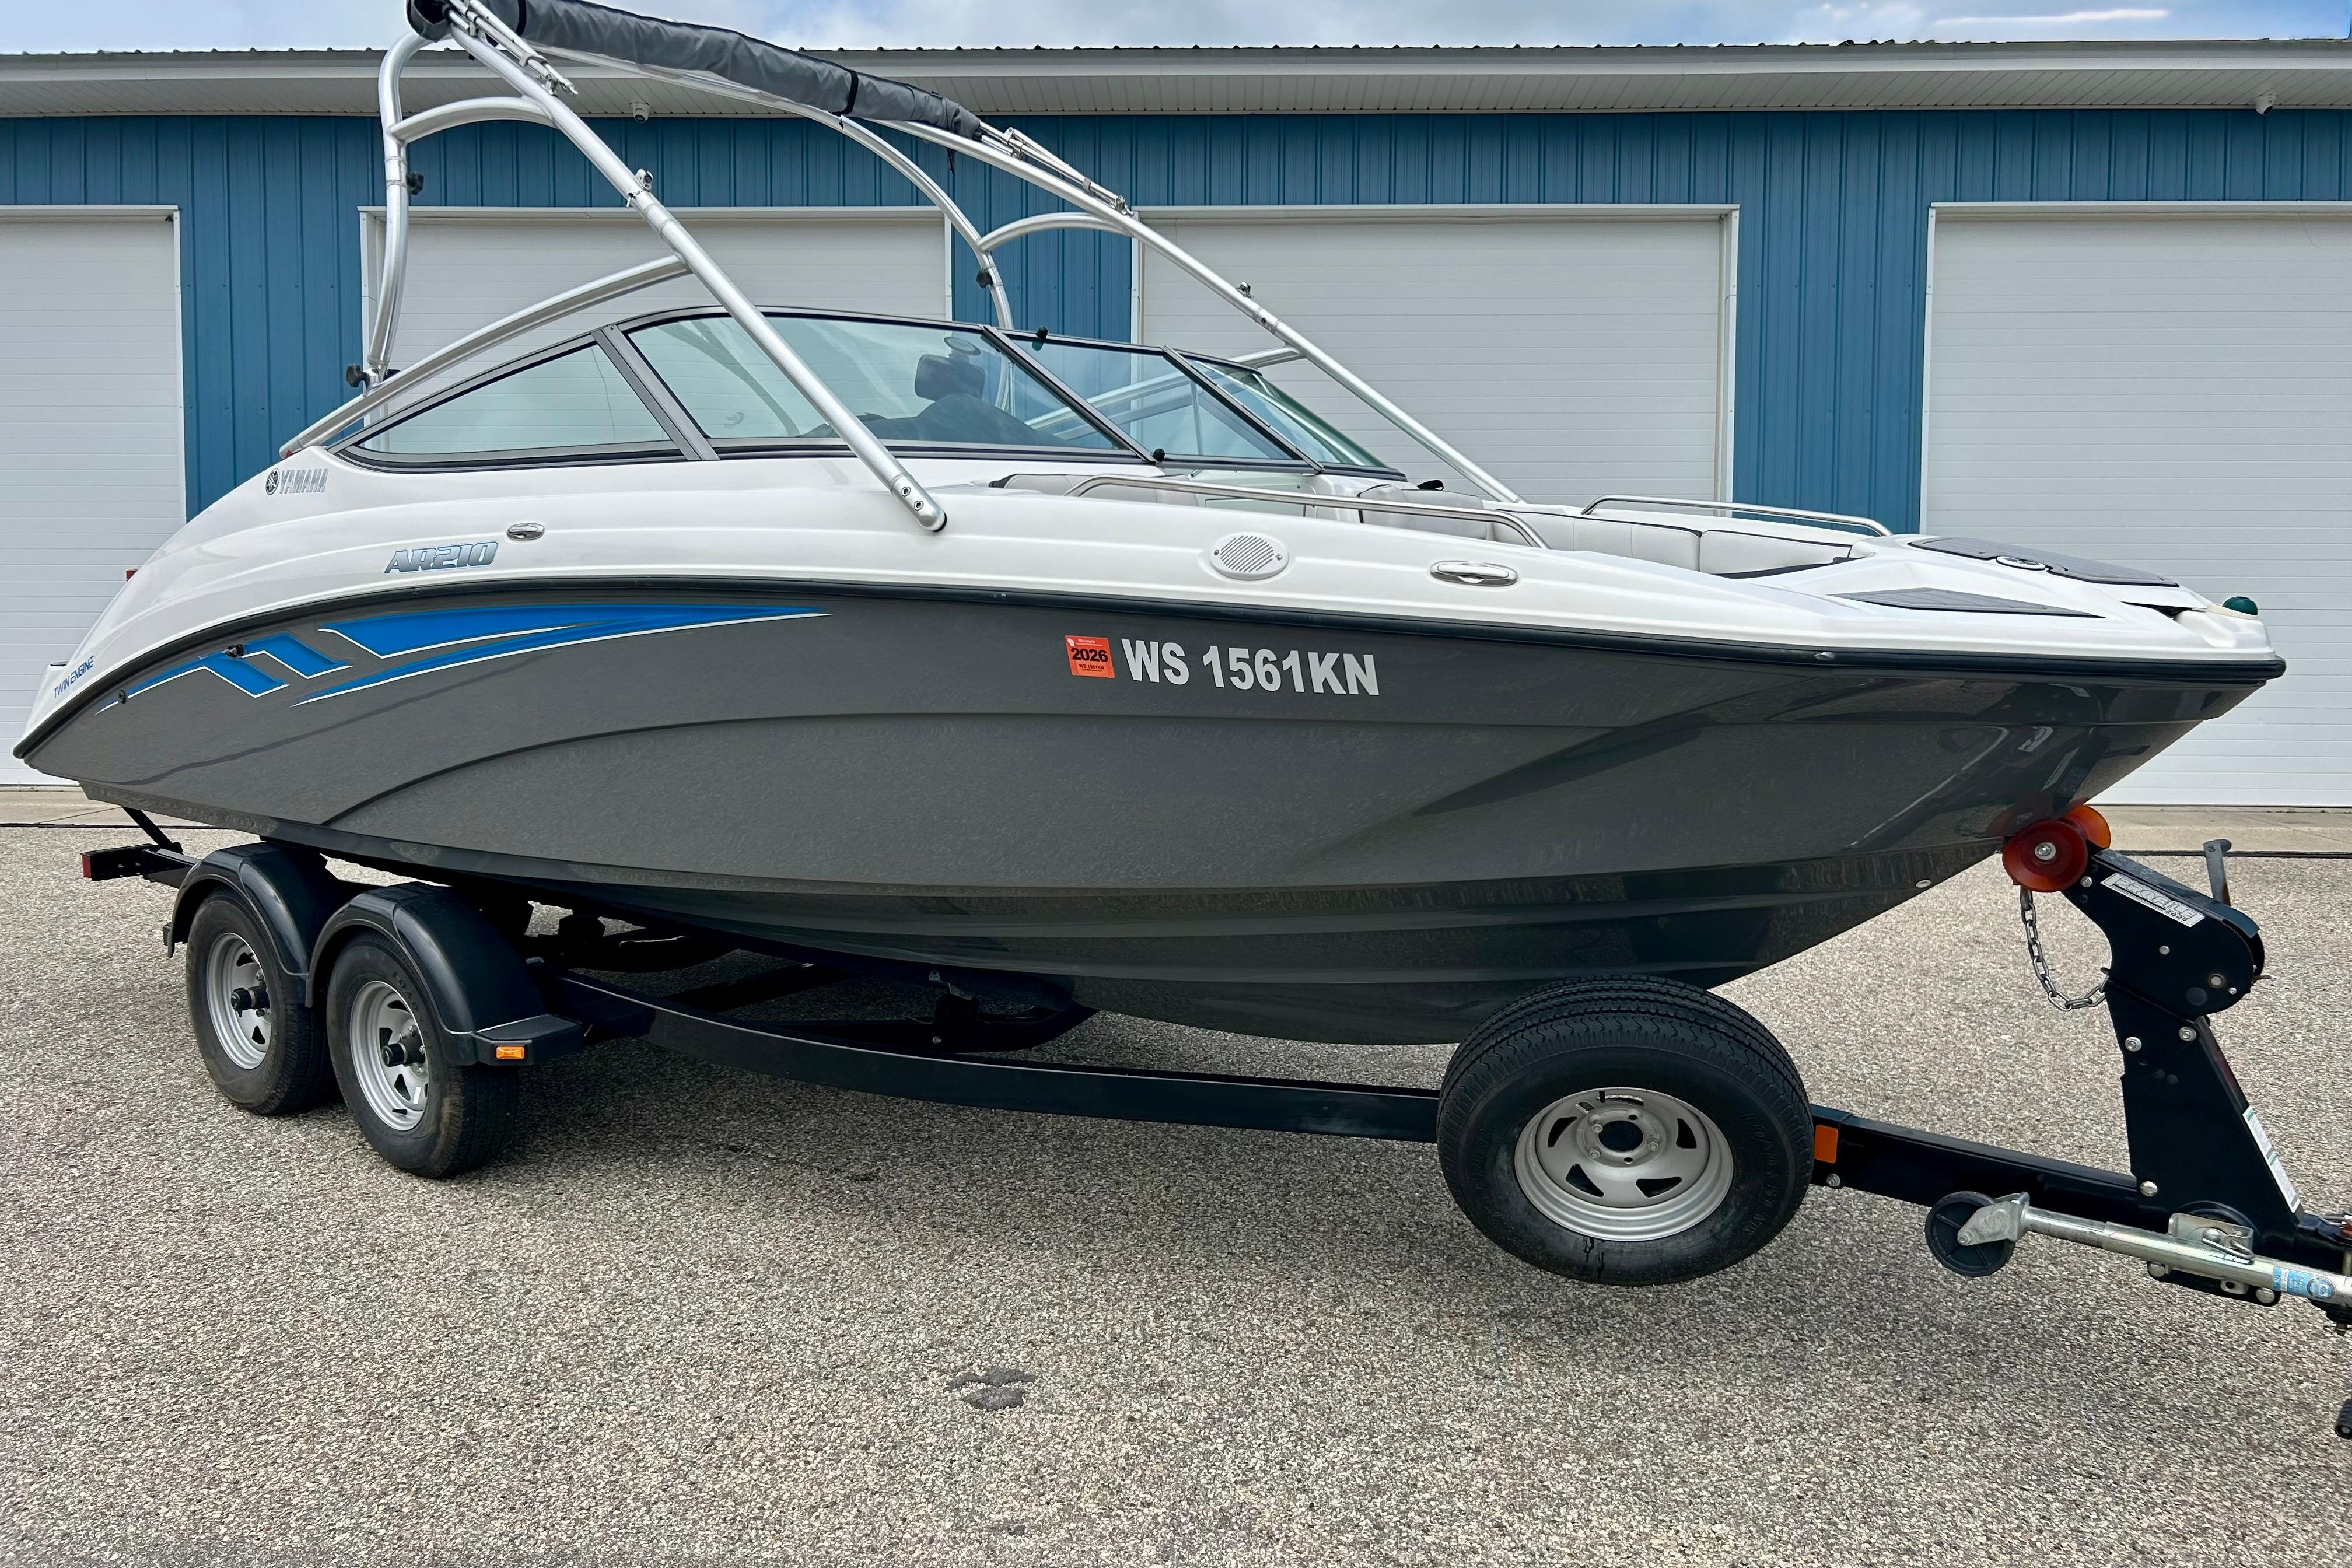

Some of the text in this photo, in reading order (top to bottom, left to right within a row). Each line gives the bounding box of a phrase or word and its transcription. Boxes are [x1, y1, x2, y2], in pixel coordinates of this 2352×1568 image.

[279, 468, 329, 494] YAMAHA
[384, 541, 498, 574] AR210
[1070, 648, 1108, 662] 2026
[1121, 638, 1380, 696] WS 1561KN
[54, 655, 94, 699] TWIN ENGINE
[2115, 877, 2198, 919] PROFILE
